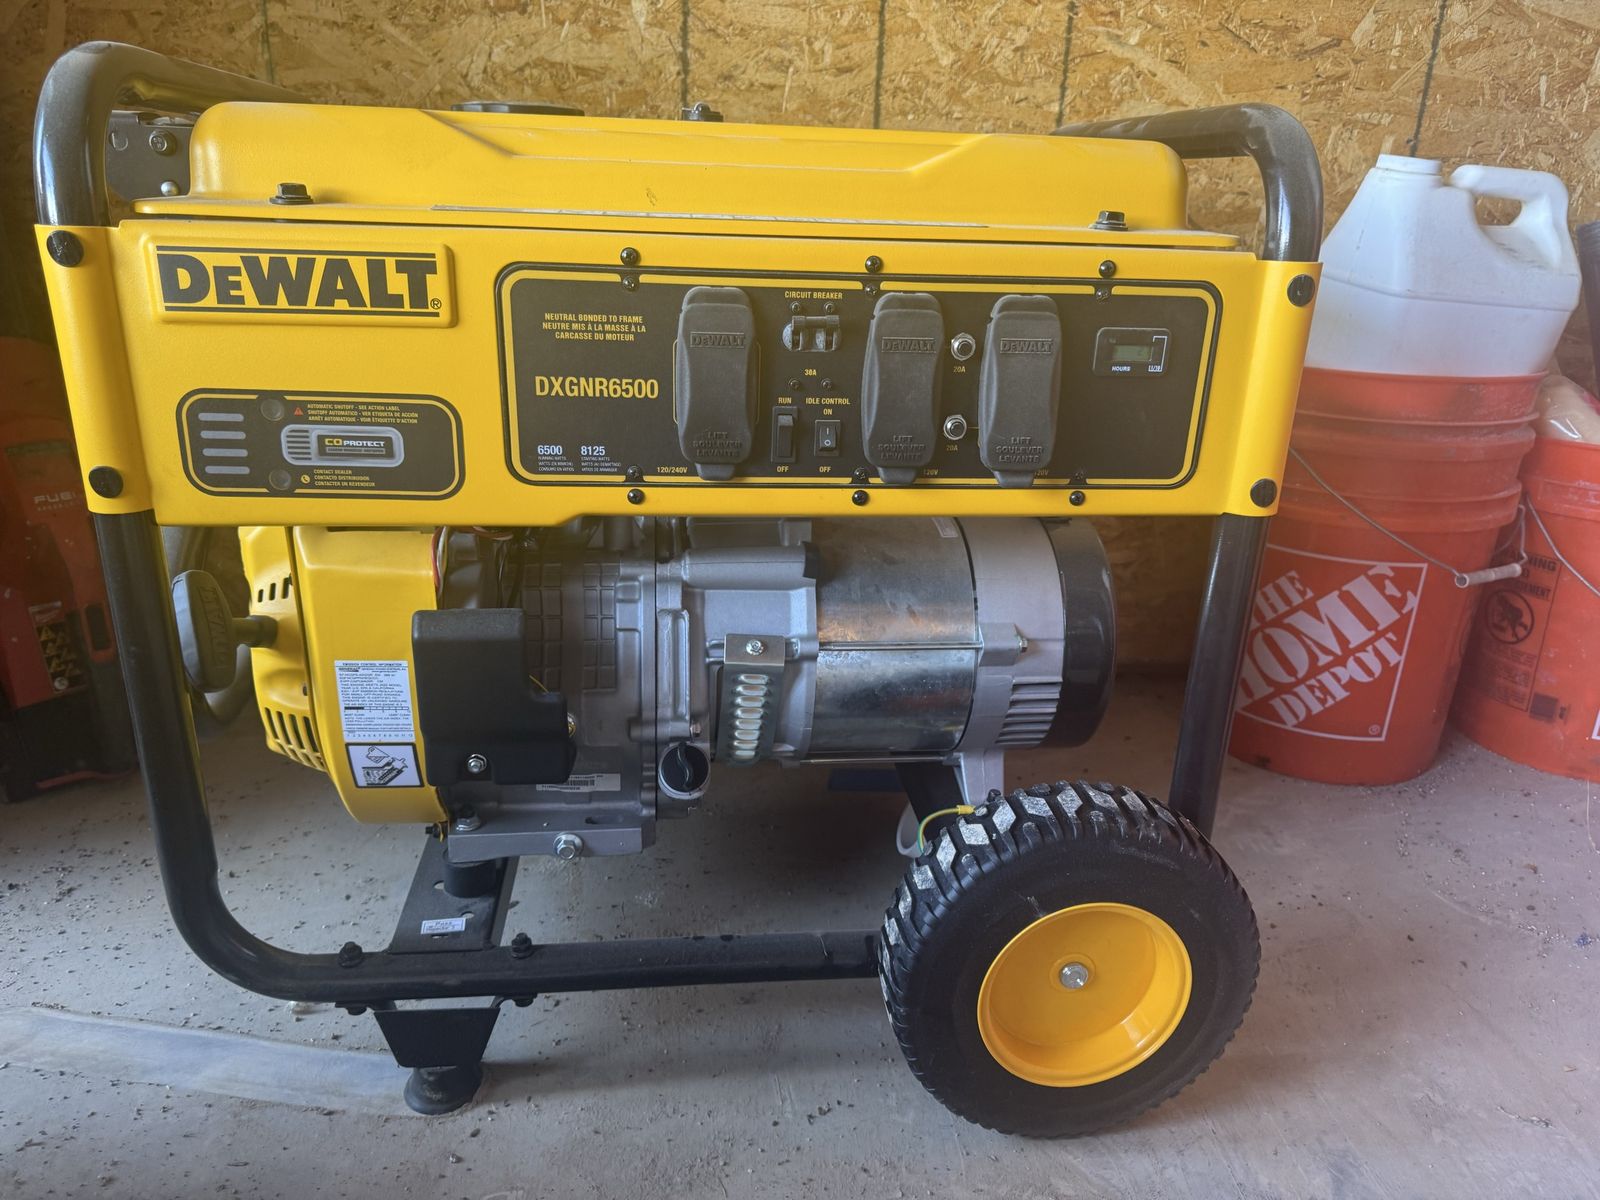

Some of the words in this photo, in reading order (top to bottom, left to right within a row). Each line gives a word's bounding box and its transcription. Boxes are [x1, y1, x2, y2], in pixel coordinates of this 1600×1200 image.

[157, 254, 437, 309] DEWALT
[544, 313, 576, 321] NEUTRAL
[587, 322, 592, 331] À
[631, 323, 635, 332] À
[555, 332, 592, 340] CARCASSE
[606, 333, 634, 341] MOTEUR
[692, 335, 744, 346] DEWALT
[884, 340, 934, 351] DEWALT
[1002, 341, 1052, 352] DEWALT
[535, 376, 658, 398] DXGNR6500
[538, 445, 562, 455] 6500
[581, 446, 606, 456] 8125
[999, 455, 1039, 463] LEVANTE
[1251, 570, 1314, 630] HE
[1270, 632, 1402, 727] DEPOT
